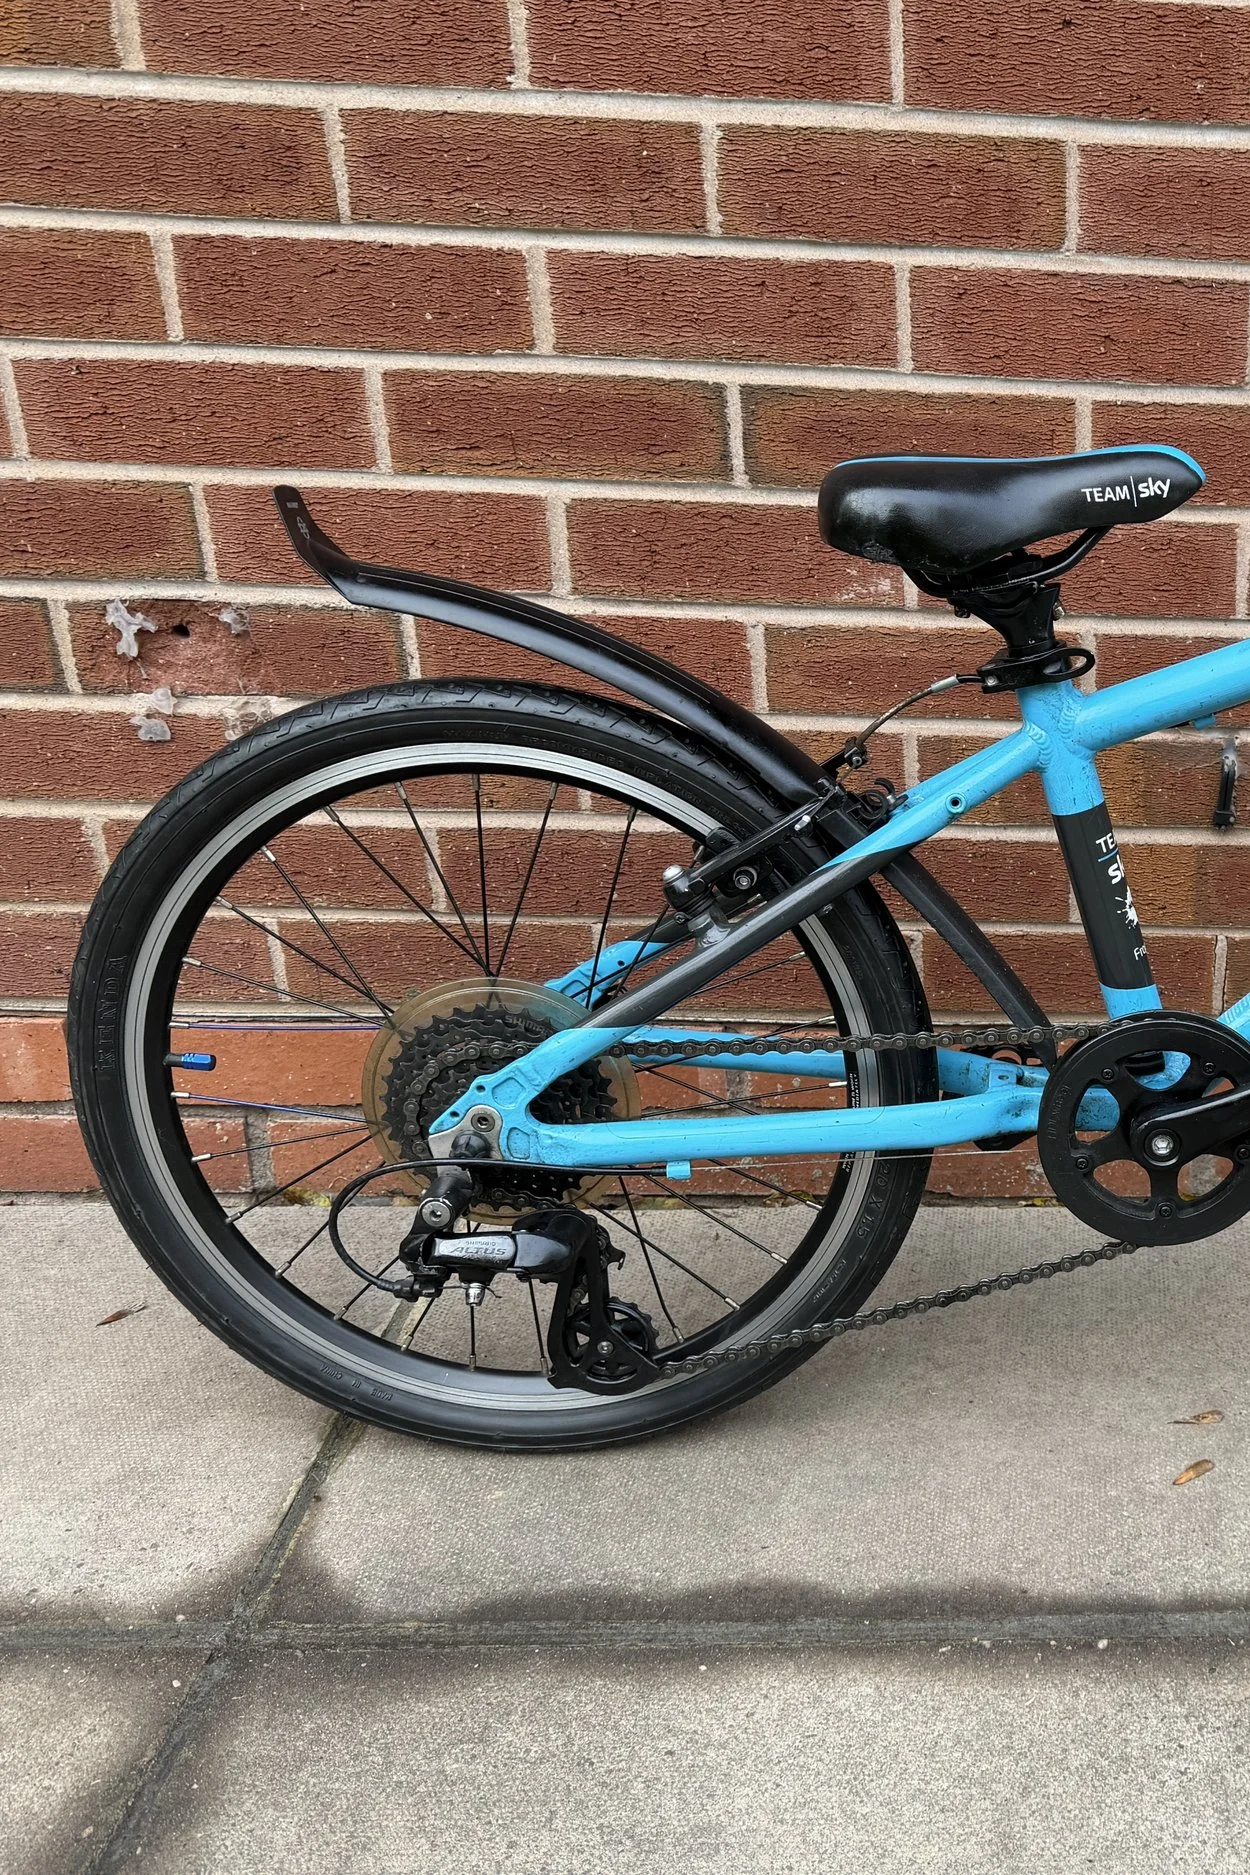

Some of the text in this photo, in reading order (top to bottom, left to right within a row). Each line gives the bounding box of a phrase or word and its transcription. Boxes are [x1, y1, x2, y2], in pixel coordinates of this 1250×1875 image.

[1081, 477, 1171, 502] TEAM sky
[1096, 832, 1118, 853] TE
[97, 955, 128, 1072] KENDA
[504, 1014, 553, 1036] SHIMA
[449, 1246, 507, 1256] ALTUS
[319, 1363, 344, 1381] CHINA
